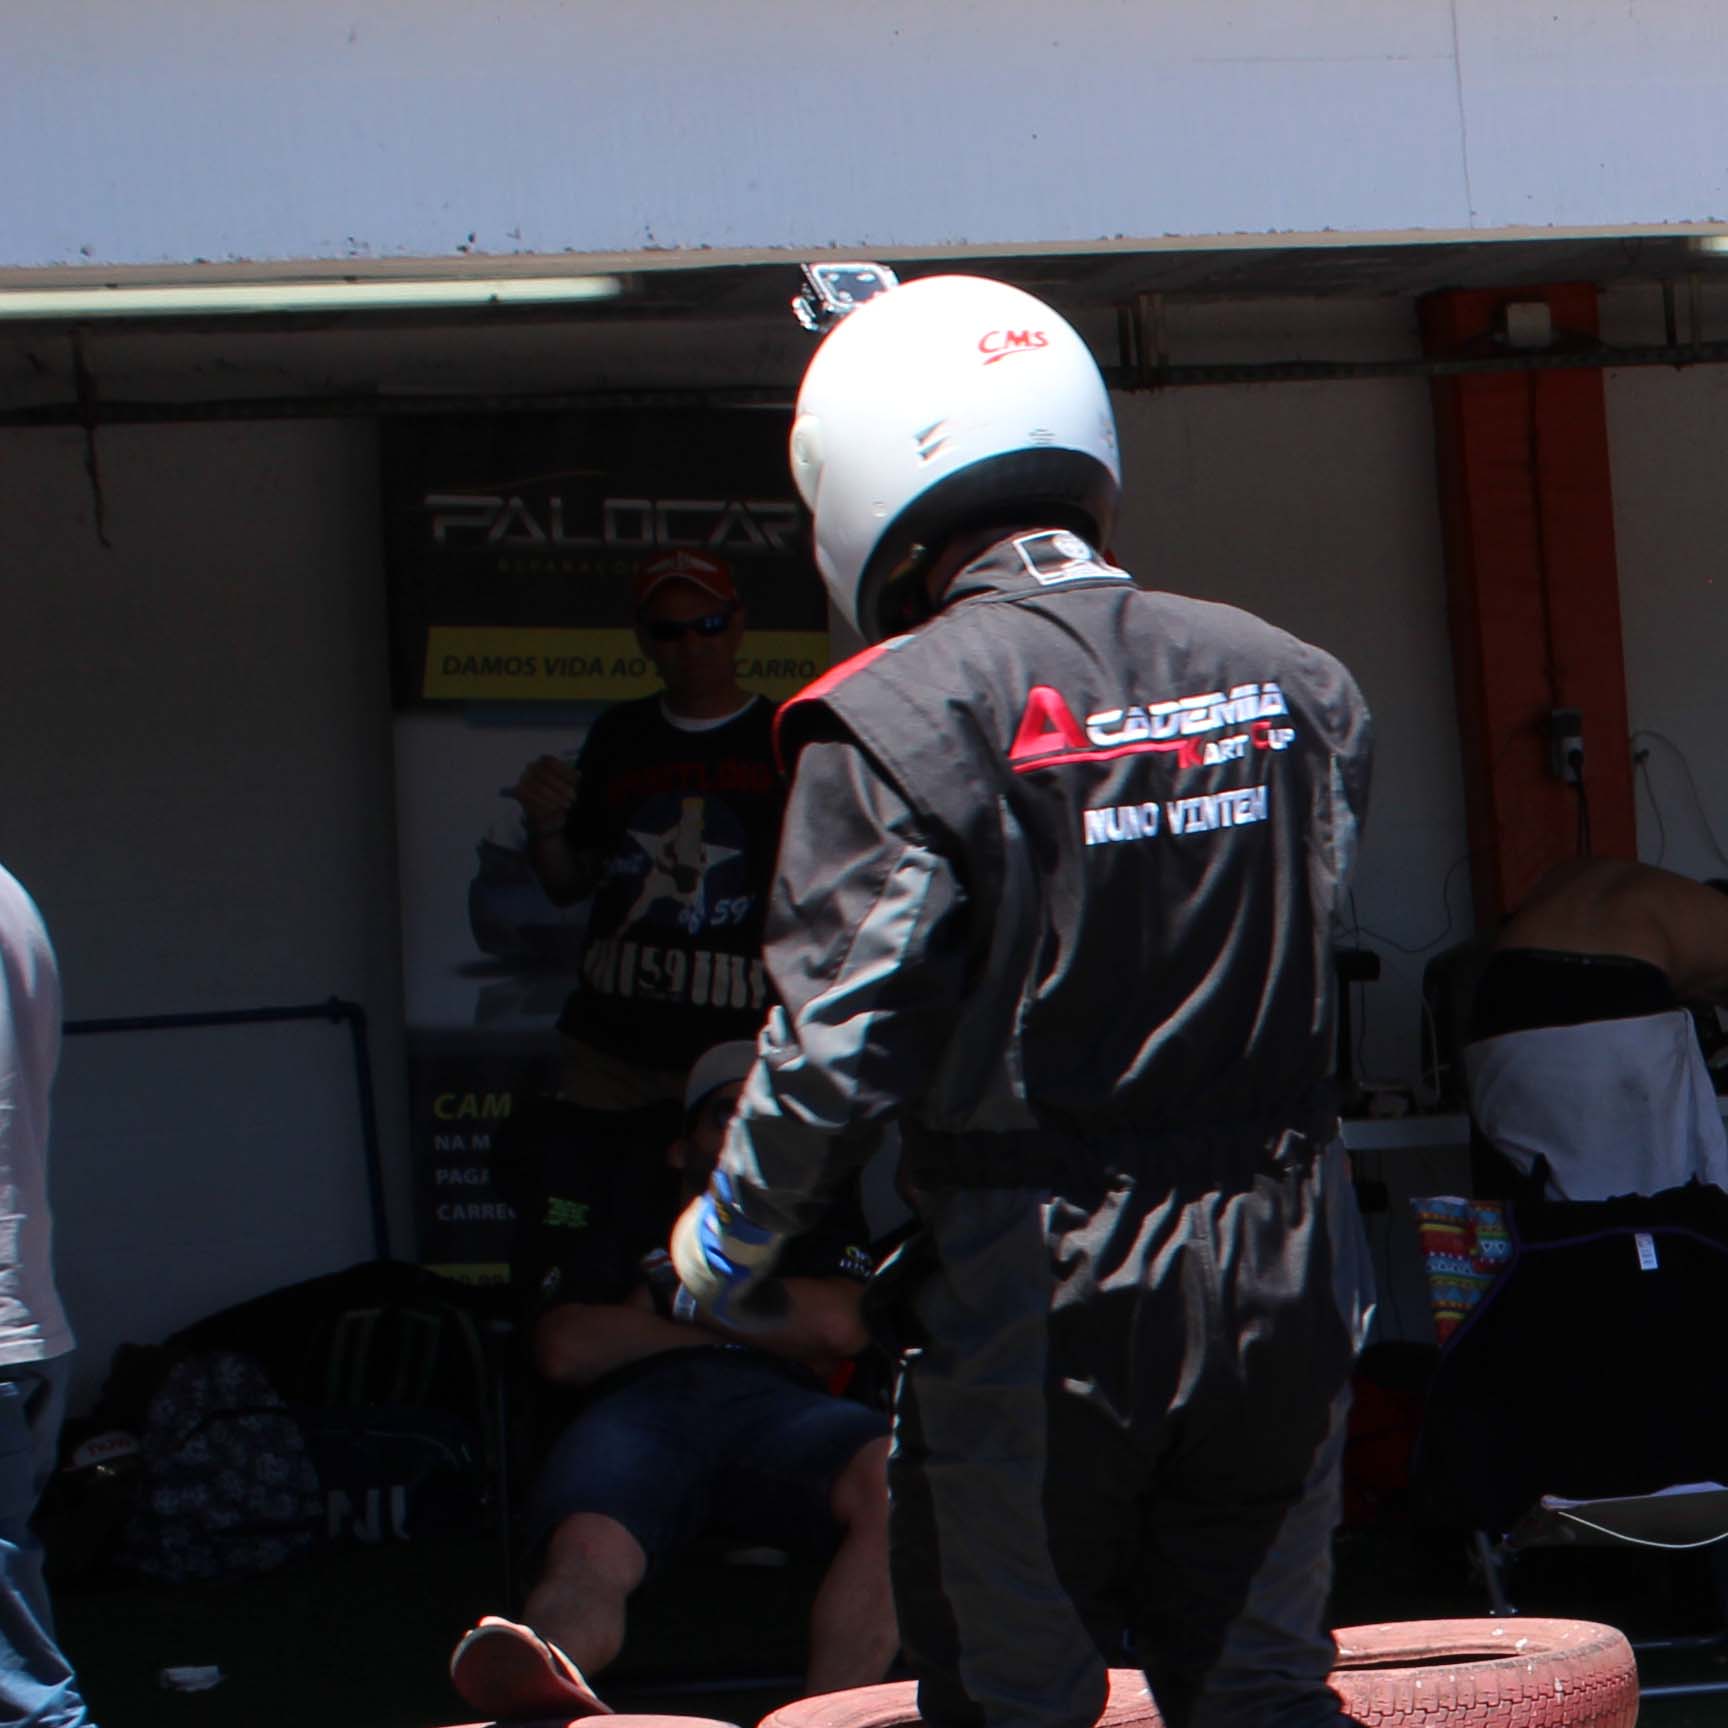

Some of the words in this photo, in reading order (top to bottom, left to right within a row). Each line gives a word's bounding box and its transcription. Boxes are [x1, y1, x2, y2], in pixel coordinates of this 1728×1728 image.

[978, 329, 1049, 354] CMS
[424, 494, 799, 550] PALOCAR
[497, 558, 642, 575] REPARAÇ
[440, 656, 537, 678] DAMOS
[543, 656, 604, 678] VIDA
[610, 657, 647, 678] AO
[1008, 682, 1289, 762] ACADEMIA
[1177, 735, 1249, 769] KART
[1252, 720, 1295, 751] CUP
[1083, 802, 1160, 846] NUNO
